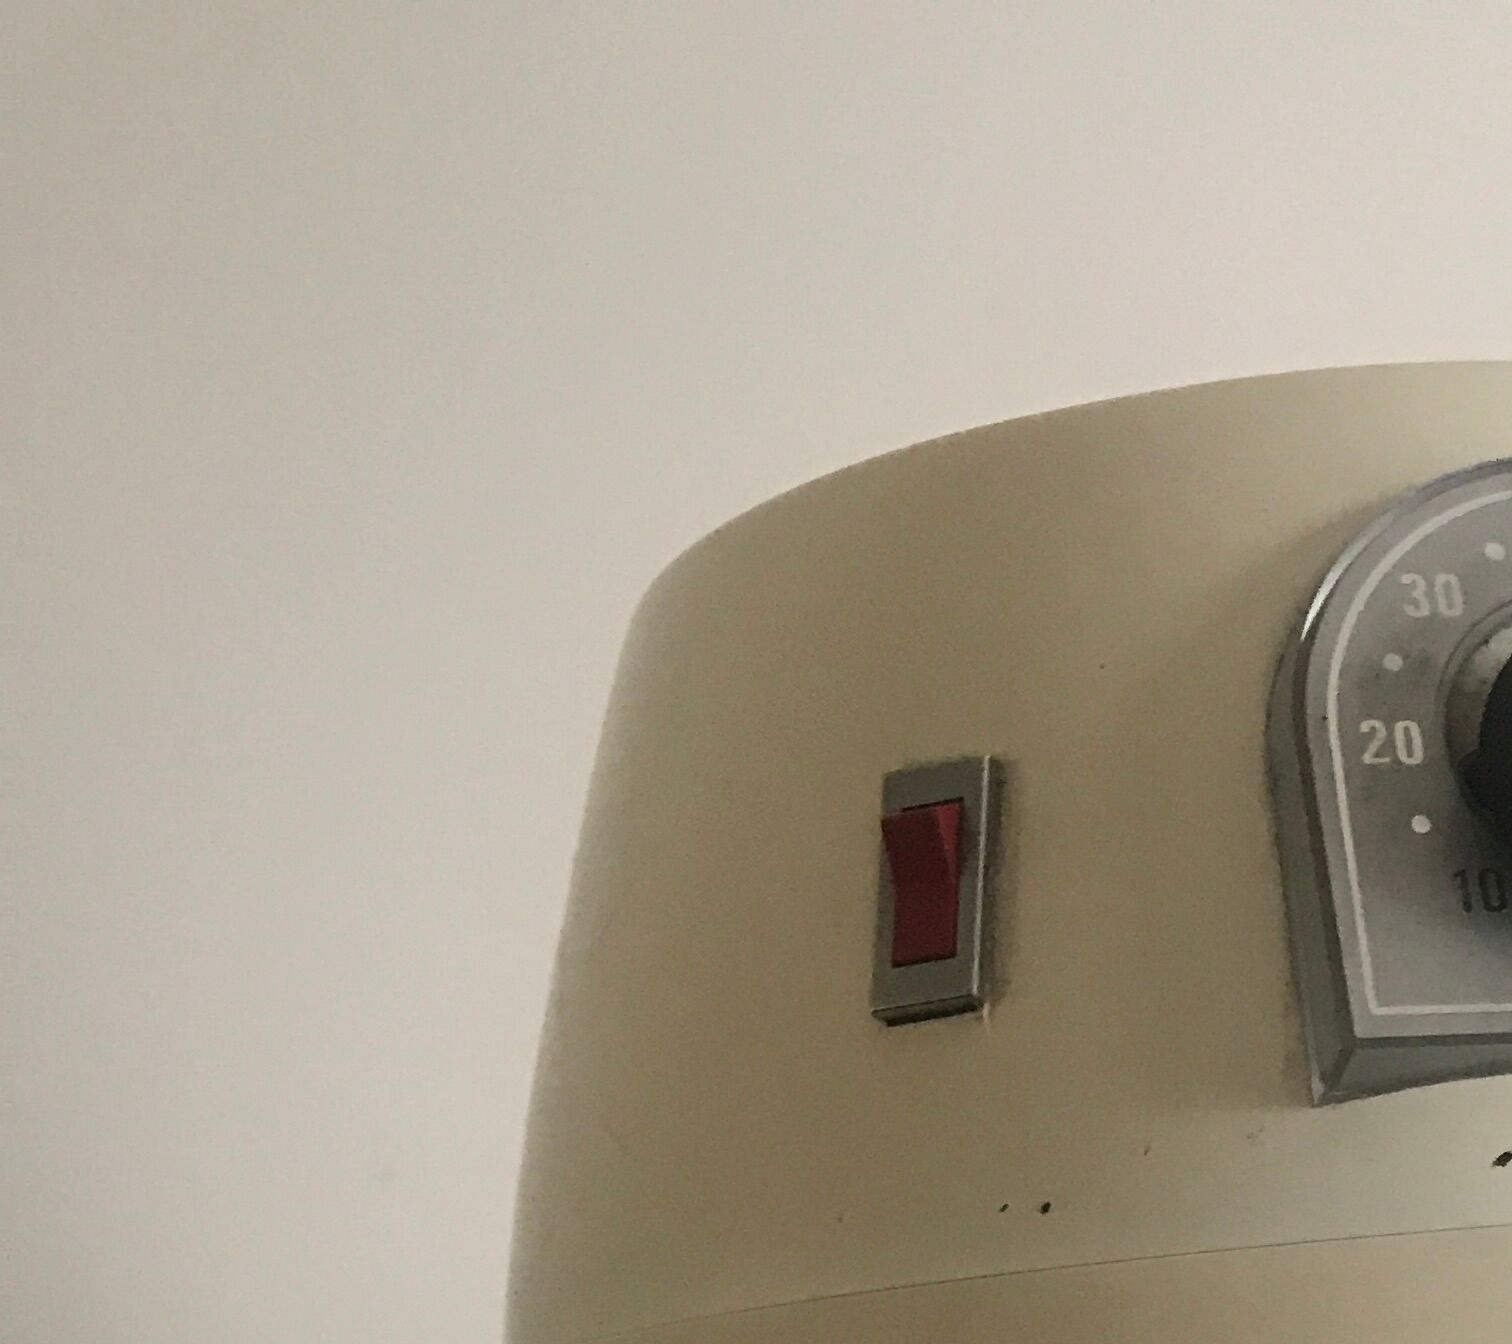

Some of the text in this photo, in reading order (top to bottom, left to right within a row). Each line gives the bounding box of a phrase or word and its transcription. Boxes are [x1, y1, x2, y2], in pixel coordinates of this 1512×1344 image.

[1400, 573, 1463, 618] 30
[1360, 720, 1423, 765] 20
[1453, 867, 1507, 913] 10
